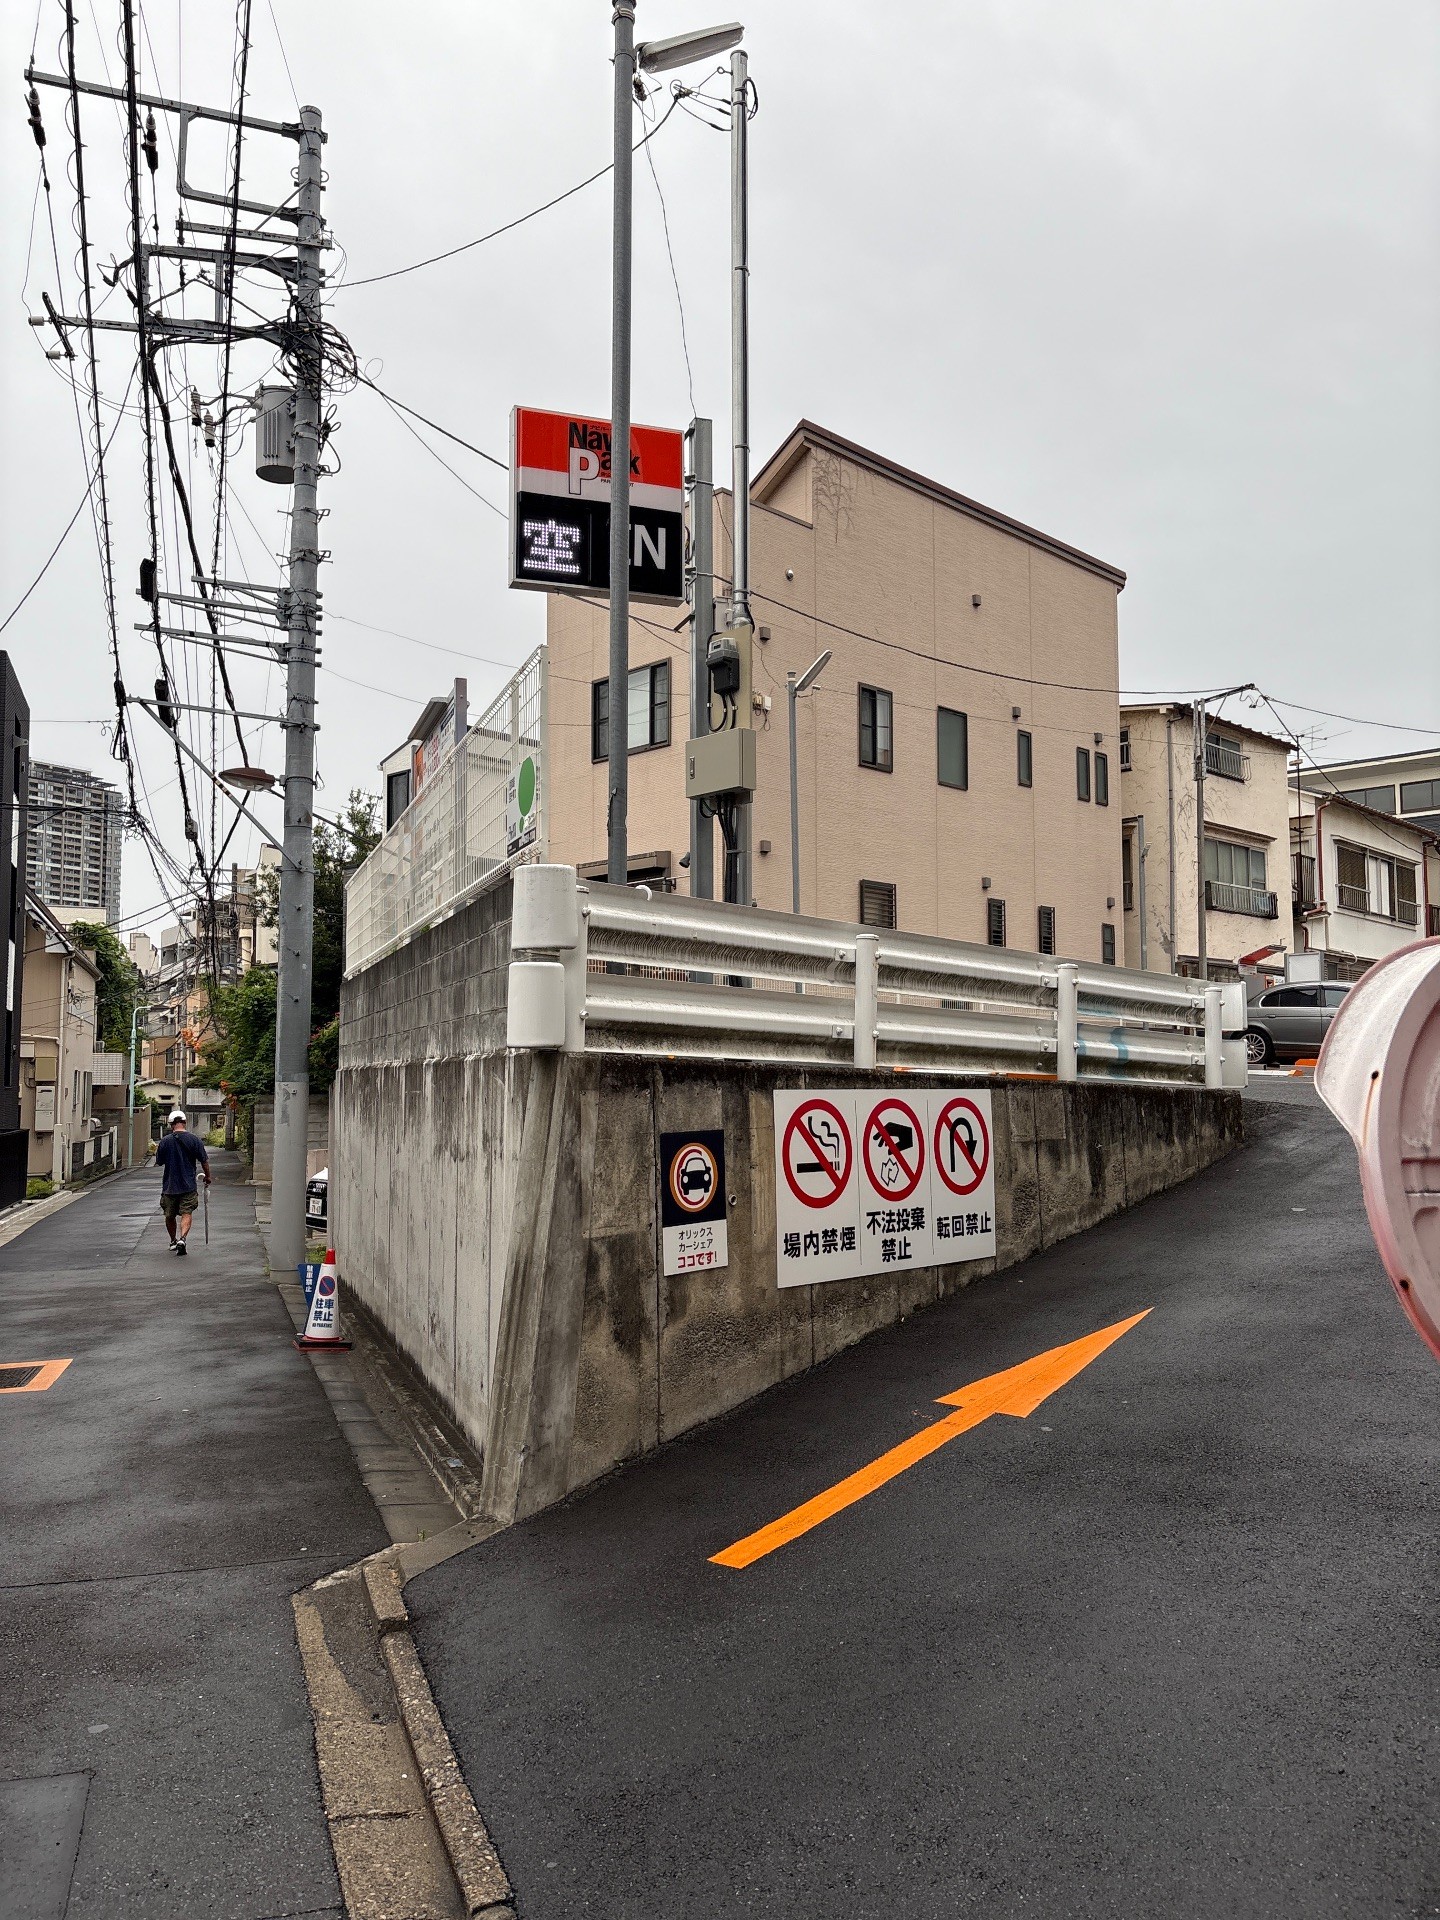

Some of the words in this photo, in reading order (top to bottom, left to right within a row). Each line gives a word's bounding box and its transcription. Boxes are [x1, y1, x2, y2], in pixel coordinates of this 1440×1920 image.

[568, 447, 641, 496] Pak
[523, 519, 580, 574] 空
[678, 1227, 713, 1240] オリックス
[866, 1207, 925, 1235] 不法投棄
[936, 1211, 992, 1239] 転回禁止
[678, 1239, 713, 1252] カーシェア
[783, 1226, 856, 1259] 場内禁煙
[881, 1236, 912, 1263] 禁止
[677, 1251, 717, 1268] ココです!
[313, 1310, 333, 1321] 禁止
[314, 1298, 334, 1309] 駐車
